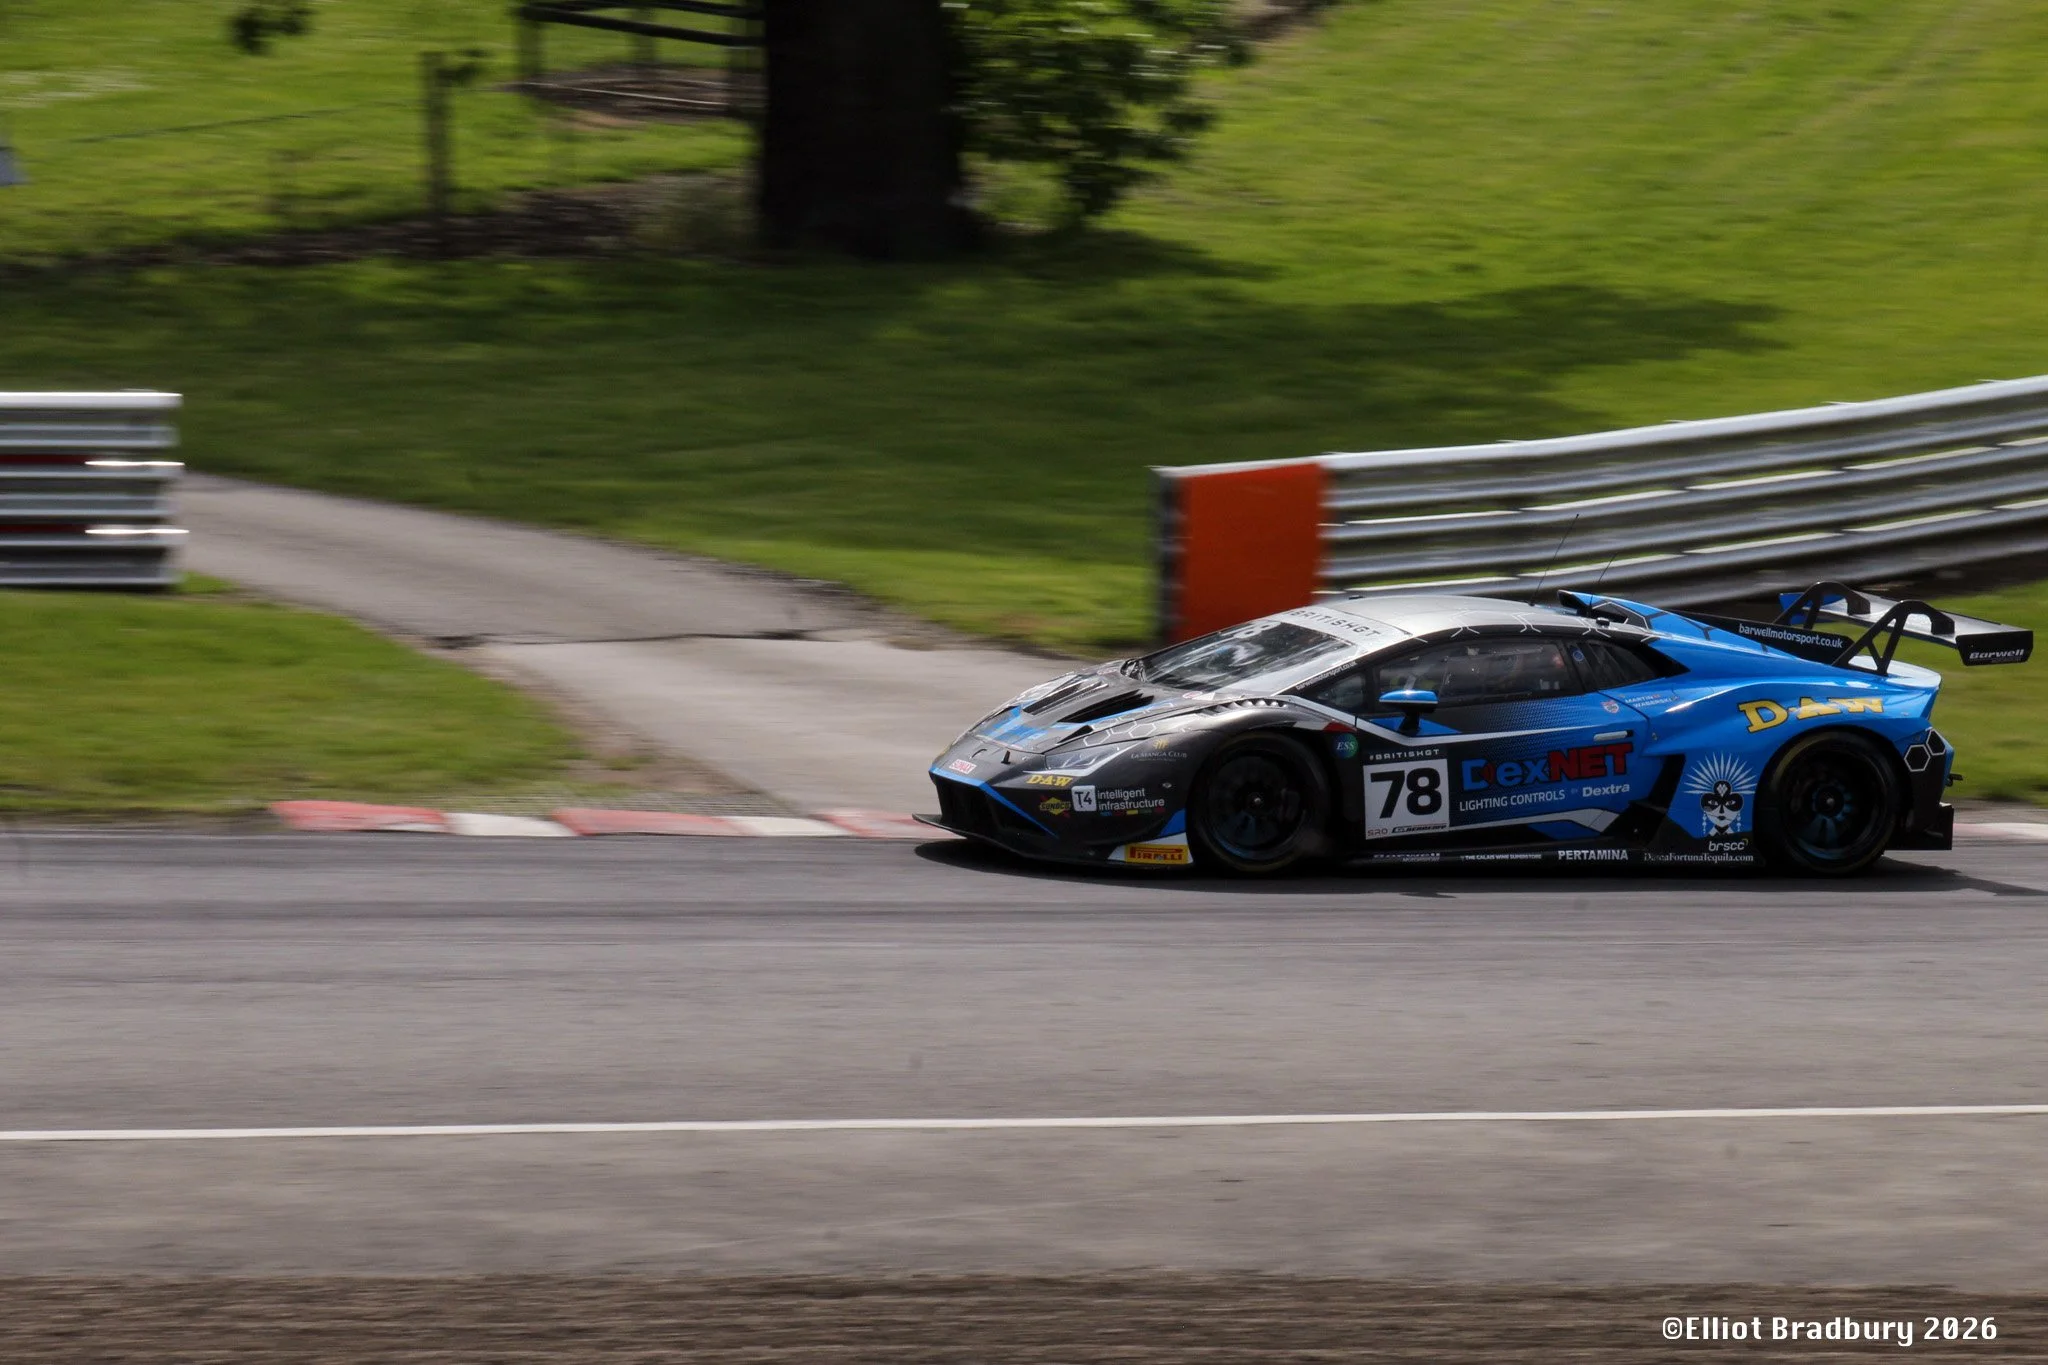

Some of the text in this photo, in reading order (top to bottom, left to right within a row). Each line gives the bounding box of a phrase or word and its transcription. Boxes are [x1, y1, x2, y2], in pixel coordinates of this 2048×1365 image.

[1738, 623, 1843, 648] barwellmotorsport.co.uk
[1969, 649, 2025, 659] Barwell
[1336, 741, 1355, 751] ESS
[1369, 748, 1440, 761] #BRITISHGT
[1461, 743, 1633, 793] DexNET
[1075, 791, 1093, 808] T4
[1097, 788, 1146, 801] intelligent
[1370, 767, 1442, 819] 78
[1459, 796, 1508, 812] LIGHTING
[1510, 789, 1566, 807] CONTROLS
[1582, 783, 1631, 798] Dextra
[1098, 798, 1166, 811] infrastructure
[1708, 840, 1746, 851] brscc
[1129, 846, 1184, 860] PIRELLI
[1557, 850, 1628, 861] PERTAMINA
